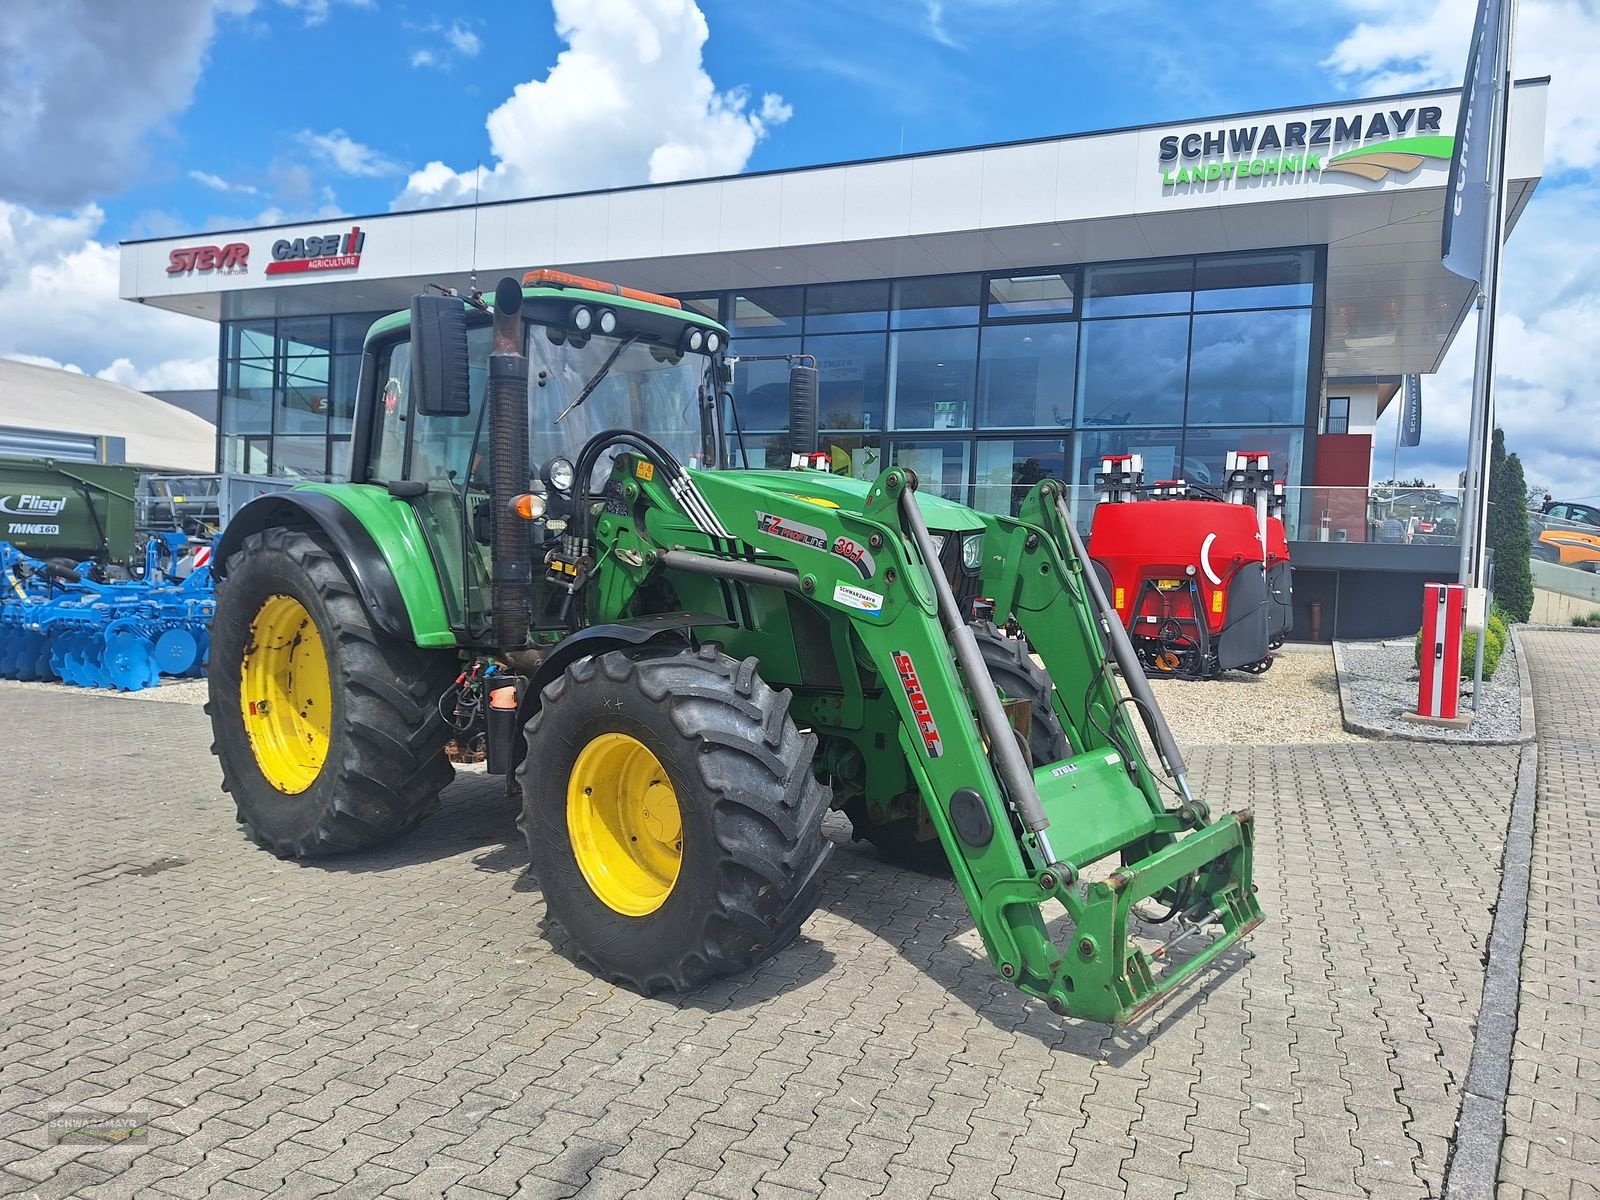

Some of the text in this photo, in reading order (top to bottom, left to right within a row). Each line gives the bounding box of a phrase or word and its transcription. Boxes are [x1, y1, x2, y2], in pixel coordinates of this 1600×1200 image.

[1159, 106, 1442, 161] SCHWARZMAYR
[1163, 153, 1321, 186] LANDTECHNIK
[165, 243, 249, 273] STEYR
[271, 235, 340, 260] CASE
[308, 257, 355, 269] AGRICULTURE
[18, 494, 67, 513] Fliegl
[8, 523, 38, 534] TMK
[762, 514, 782, 534] FZ
[839, 586, 876, 603] SCHWARZMAYR
[895, 655, 940, 749] STOLL
